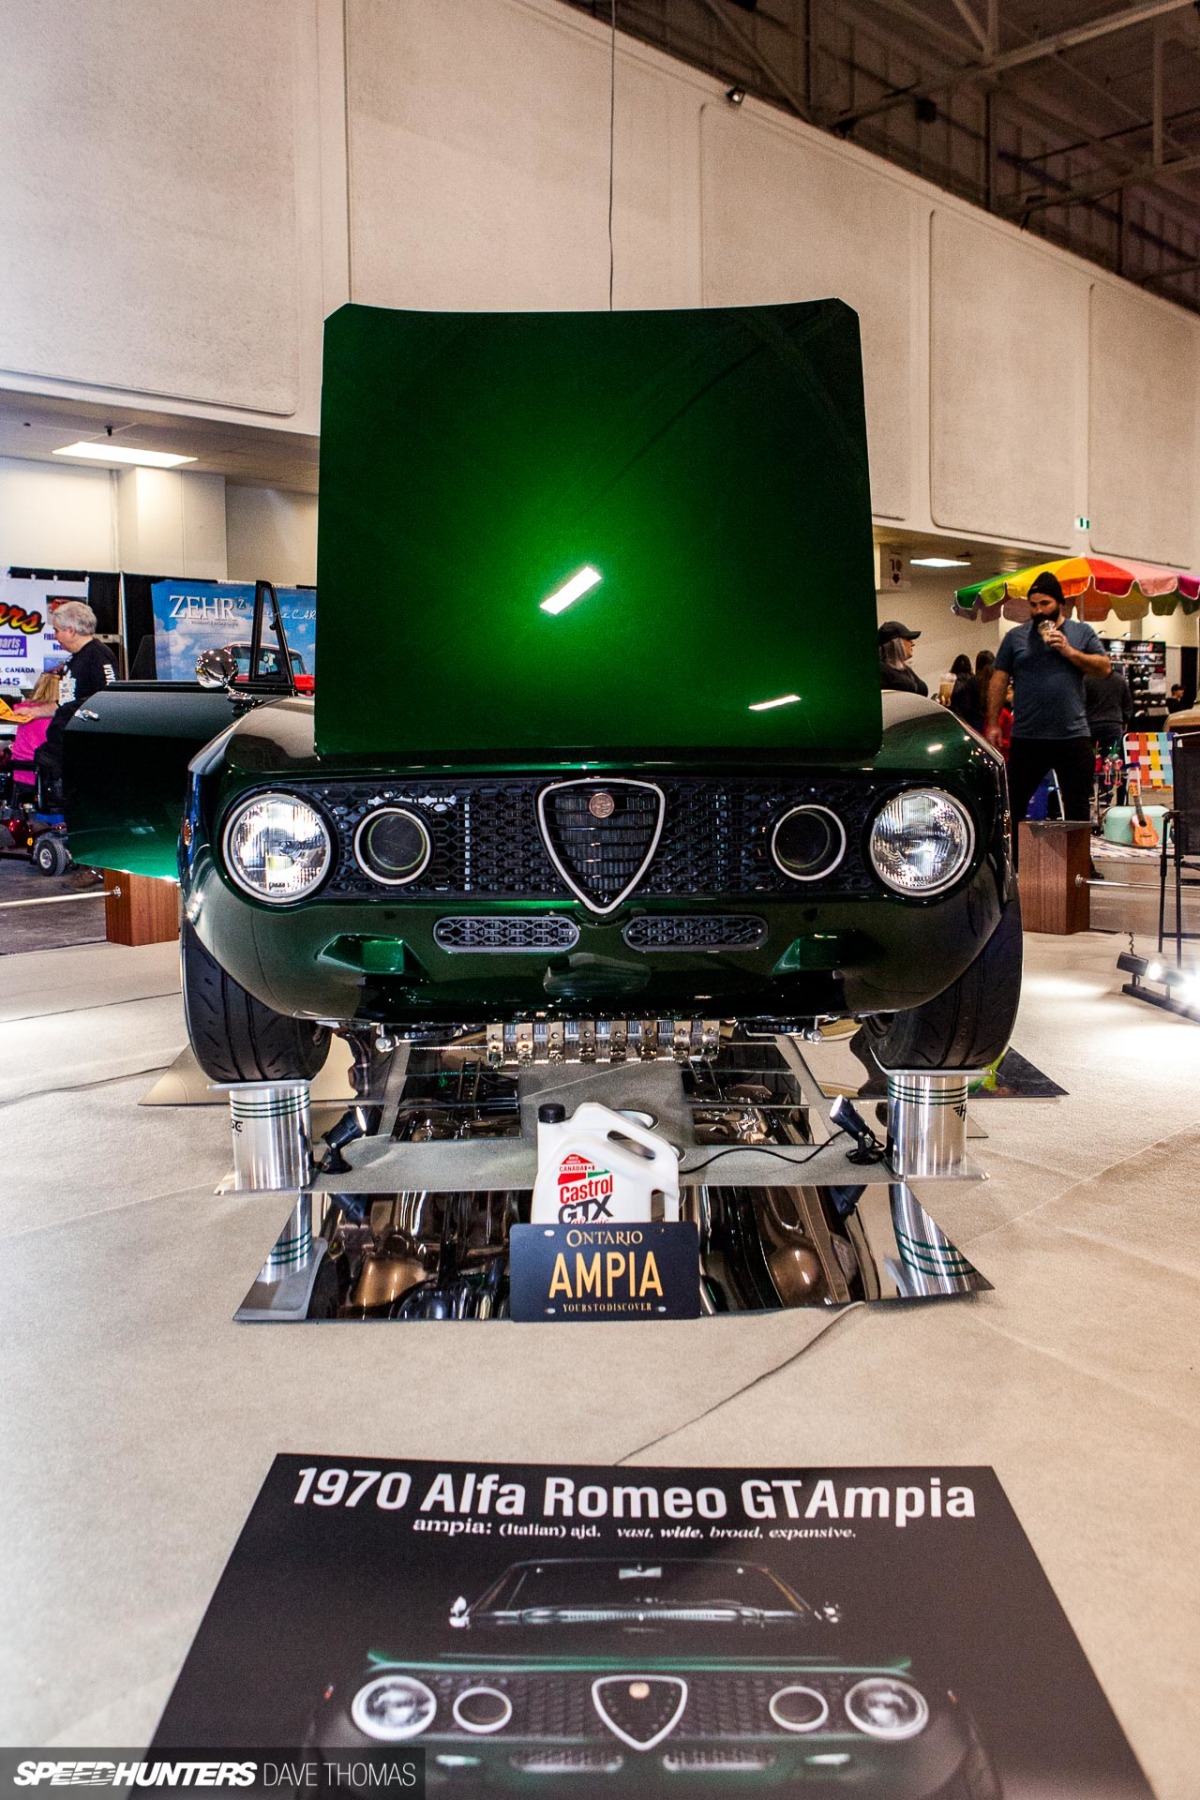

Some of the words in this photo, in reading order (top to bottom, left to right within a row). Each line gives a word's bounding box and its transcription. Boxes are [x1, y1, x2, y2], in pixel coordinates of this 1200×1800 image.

[169, 595, 238, 620] ZEHR
[560, 1174, 613, 1204] Castrol
[558, 1194, 614, 1225] GTX
[548, 1251, 664, 1298] AMPIA
[294, 1467, 412, 1510] 1970
[420, 1472, 526, 1515] Alfa
[543, 1476, 727, 1518] Romeo
[740, 1477, 976, 1527] GTAmpia
[413, 1516, 492, 1537] ampia:
[499, 1524, 567, 1538] (Italian)
[570, 1524, 601, 1539] ajd.
[617, 1527, 654, 1539] vast,
[660, 1526, 703, 1540] wide,
[709, 1526, 763, 1540] broad,
[768, 1527, 857, 1540] expansive.
